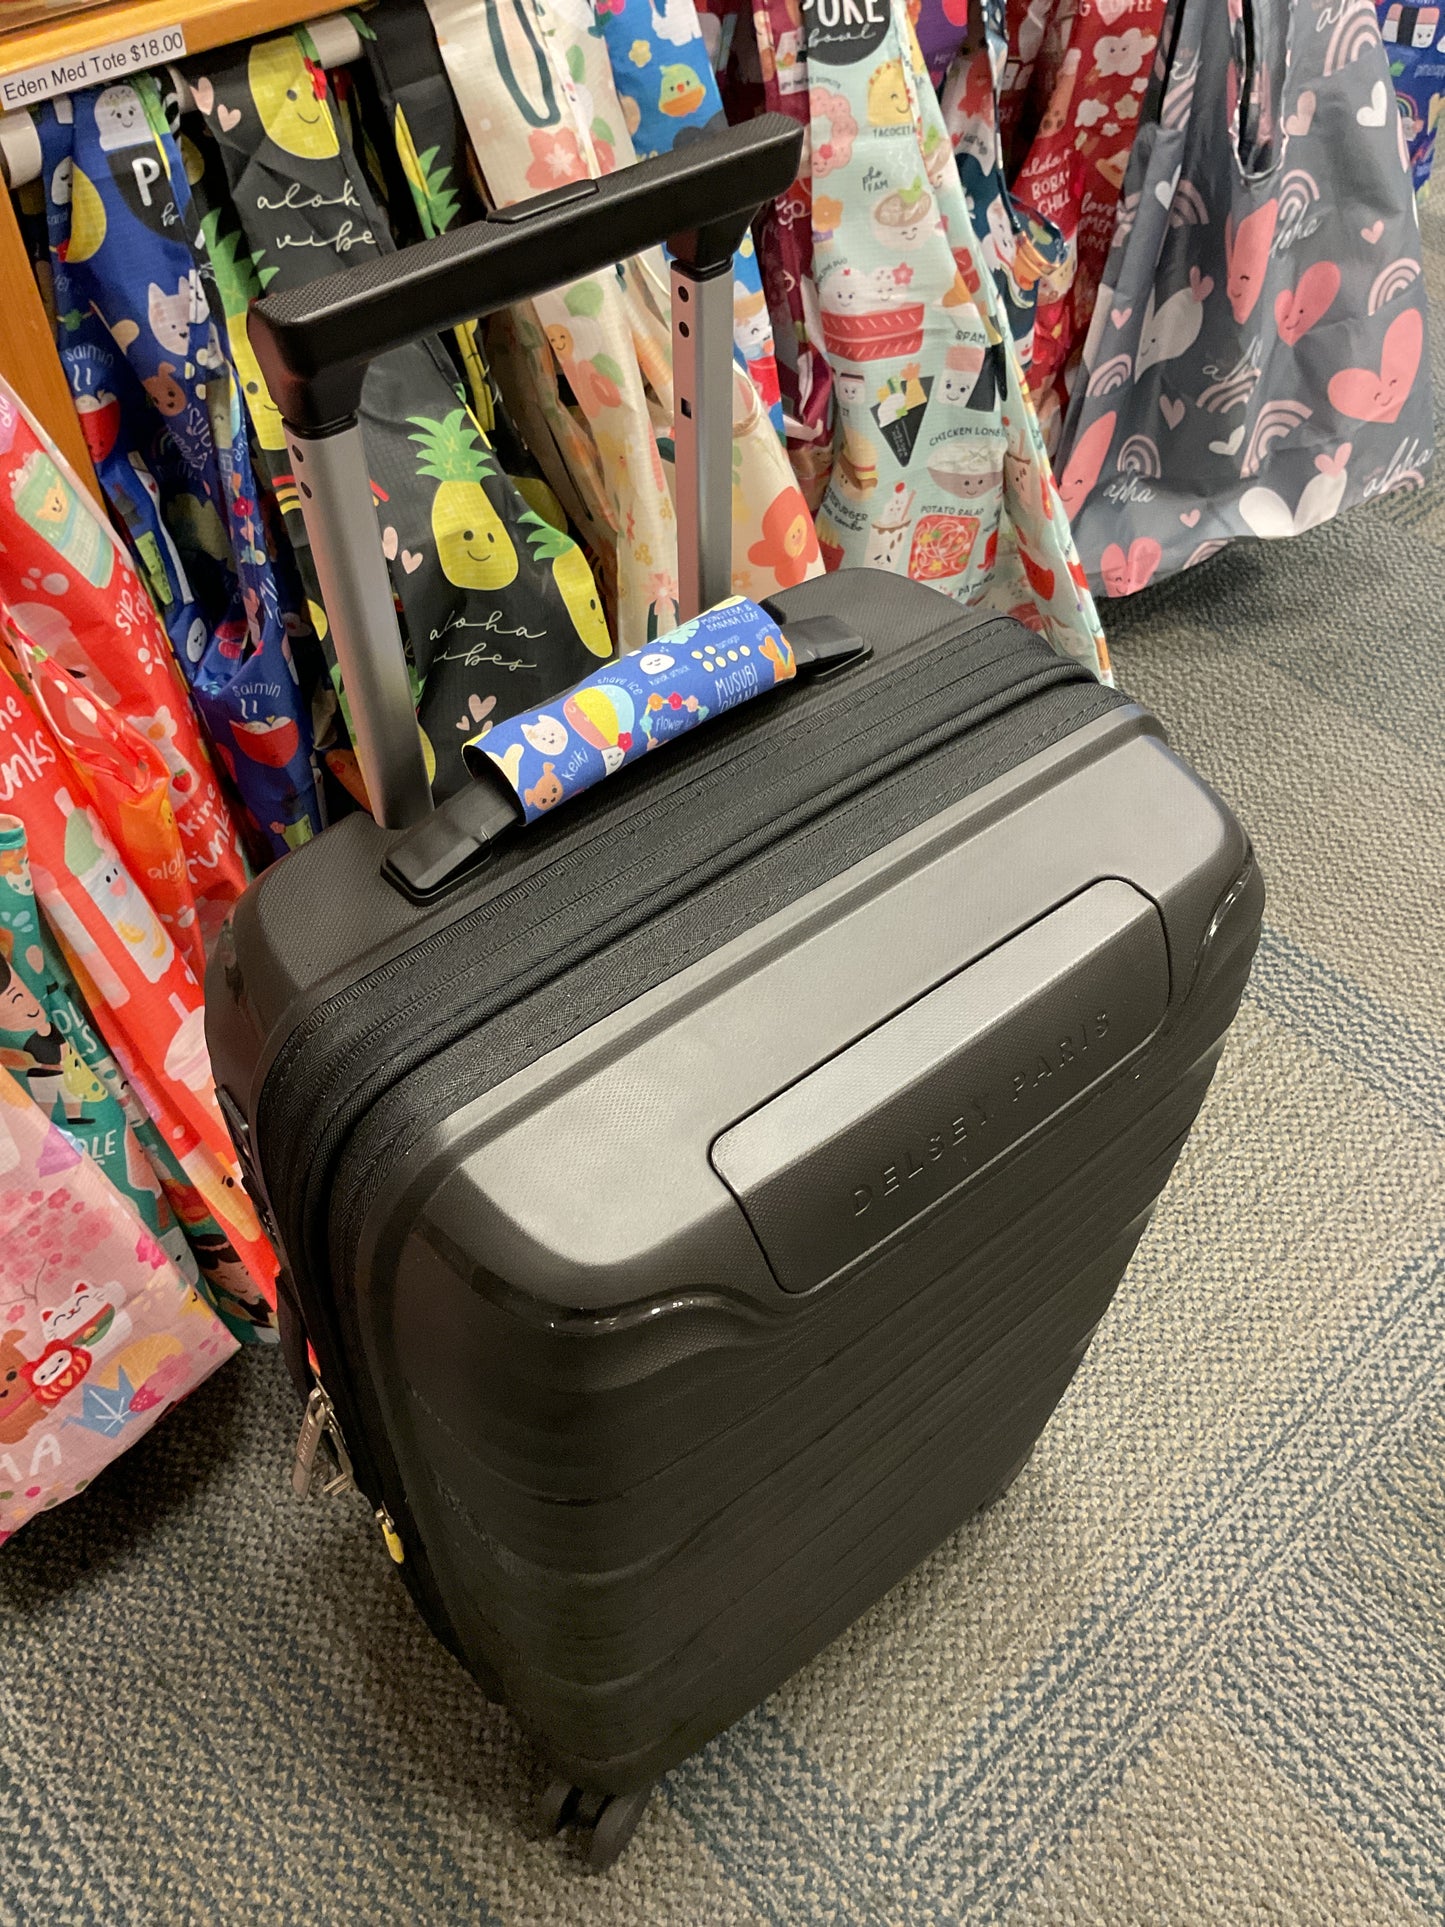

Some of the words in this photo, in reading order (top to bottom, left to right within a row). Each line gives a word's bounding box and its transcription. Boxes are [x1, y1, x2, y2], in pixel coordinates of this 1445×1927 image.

[4, 77, 48, 101] Eden
[51, 61, 88, 87] Med
[89, 54, 127, 74] Tote
[130, 32, 183, 63] $18.00
[257, 178, 361, 210] aloh
[276, 220, 377, 253] vibe
[955, 330, 986, 345] SPAM
[929, 426, 972, 447] CHICKEN
[706, 615, 741, 632] BANANA
[740, 610, 759, 624] LEAF
[232, 681, 281, 698] saimin
[715, 662, 759, 708] MUSUBI
[178, 782, 216, 835] kine
[1011, 1012, 1110, 1103] PARIS
[854, 1097, 990, 1217] DELSEY
